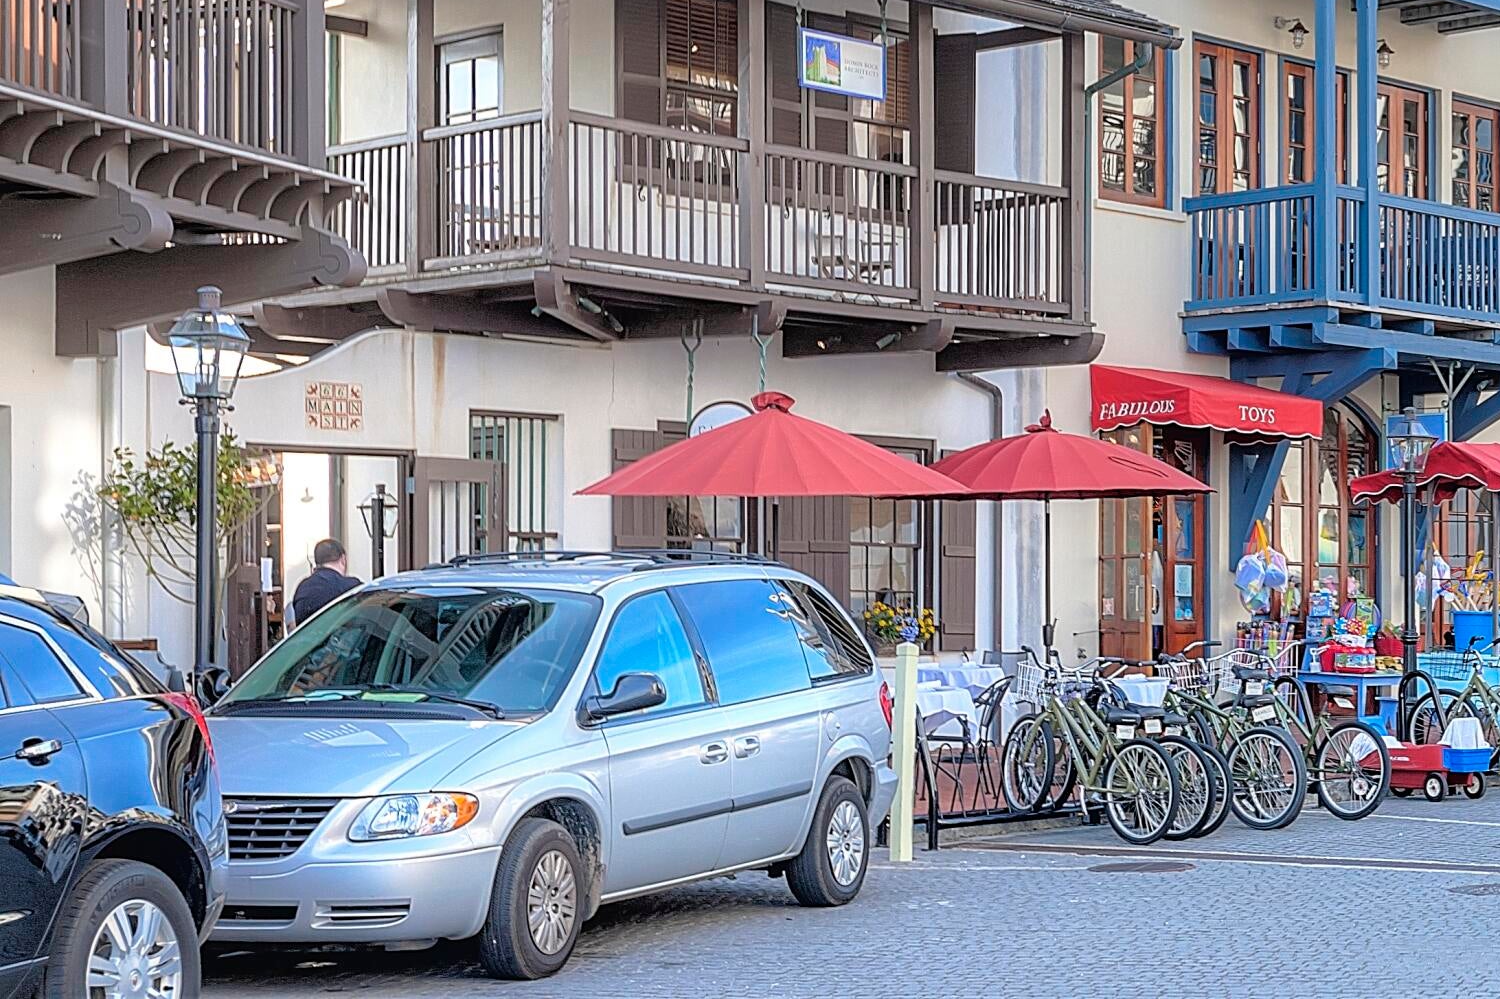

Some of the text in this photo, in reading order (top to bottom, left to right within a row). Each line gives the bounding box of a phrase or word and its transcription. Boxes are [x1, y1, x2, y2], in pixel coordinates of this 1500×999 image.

[308, 398, 361, 415] MAIN
[1099, 400, 1175, 421] FABULOUS
[1238, 405, 1275, 424] TOYS
